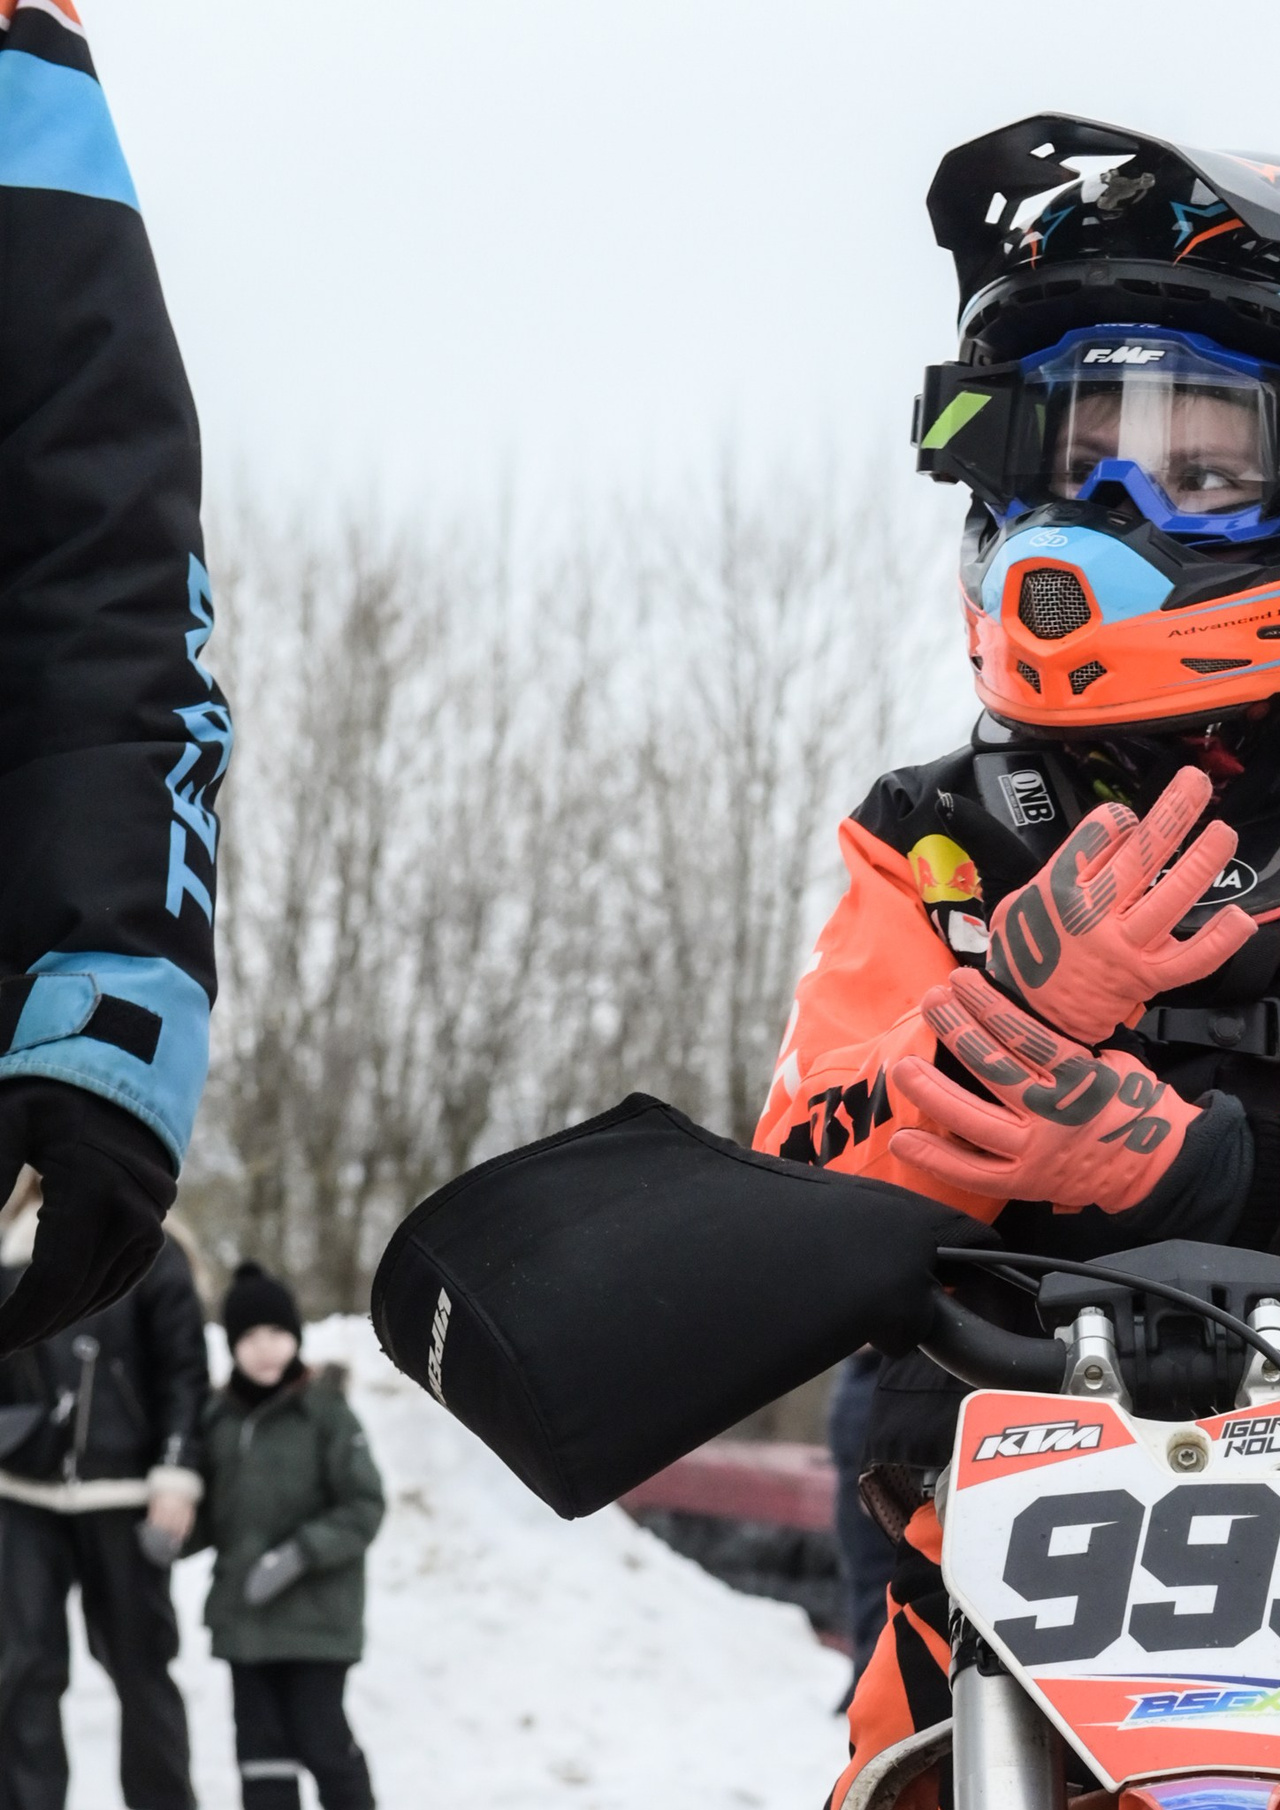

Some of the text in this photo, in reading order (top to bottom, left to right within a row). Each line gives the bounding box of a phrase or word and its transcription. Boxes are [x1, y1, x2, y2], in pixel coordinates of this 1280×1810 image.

[1083, 346, 1165, 364] FMF
[1167, 611, 1272, 638] Advanced
[1010, 769, 1055, 823] ONB
[972, 1420, 1104, 1462] KTM
